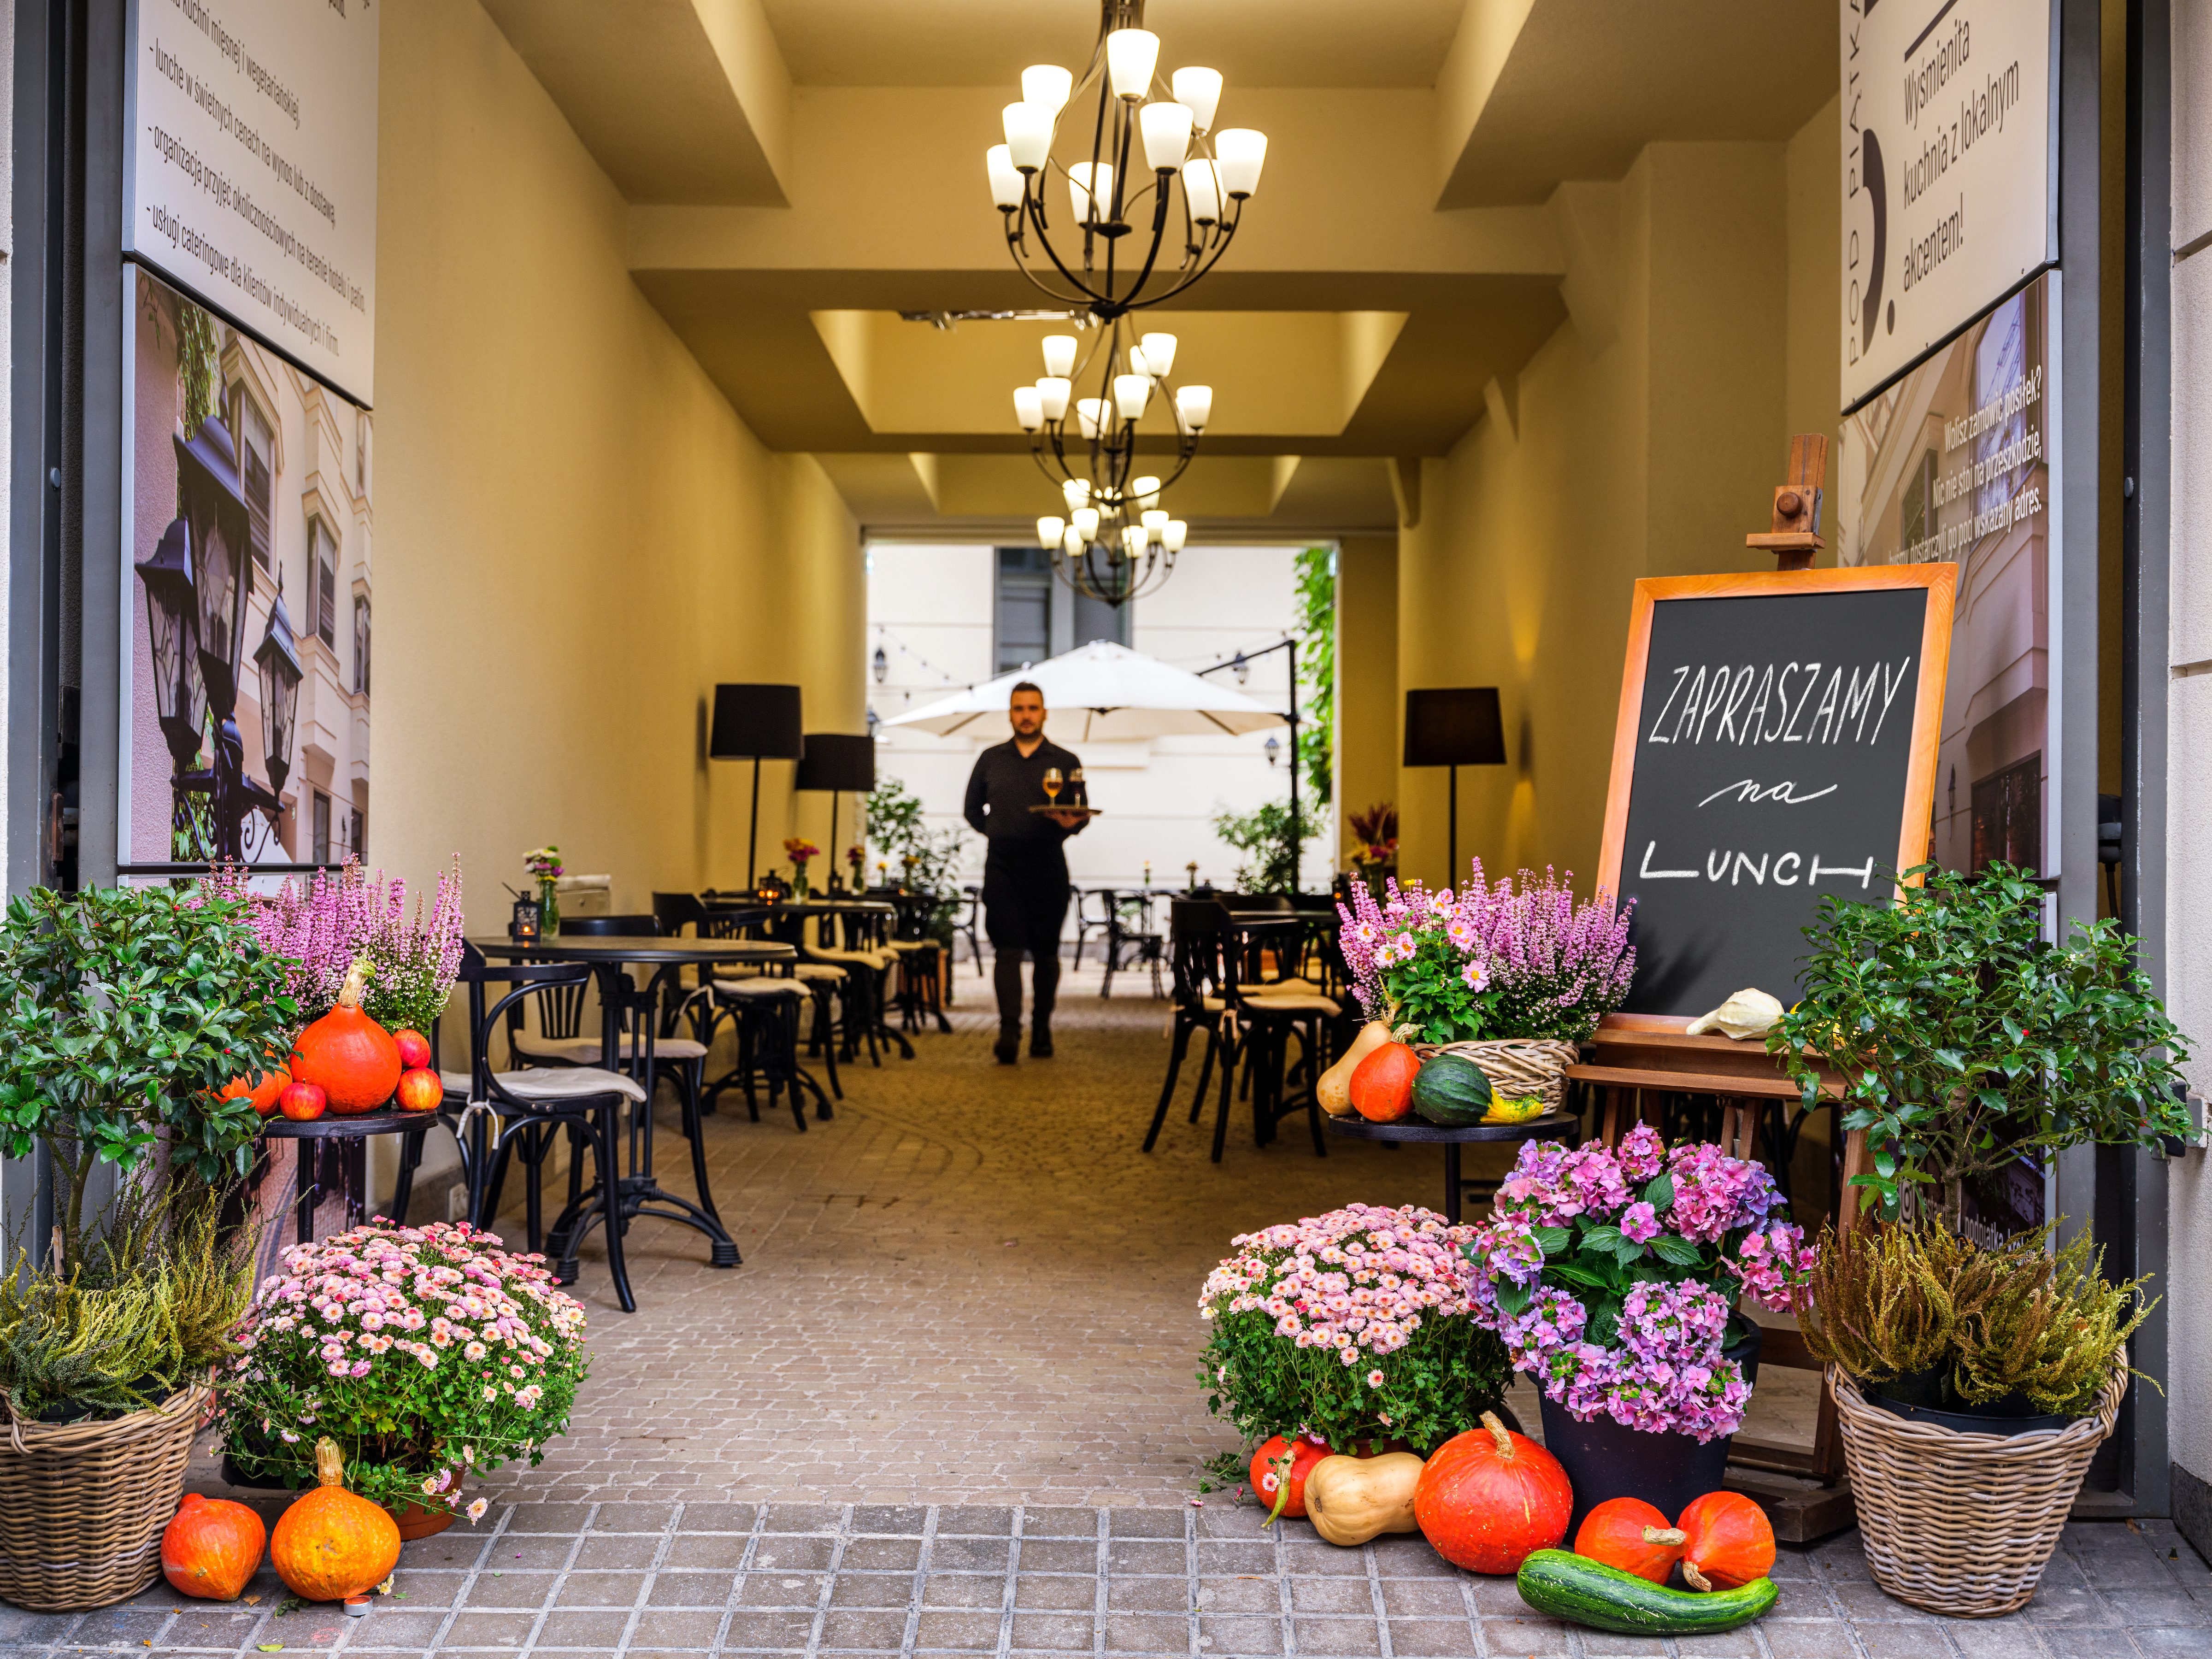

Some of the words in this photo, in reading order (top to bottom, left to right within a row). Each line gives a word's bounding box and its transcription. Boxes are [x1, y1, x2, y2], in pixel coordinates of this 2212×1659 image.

[156, 37, 183, 89] lunche
[186, 72, 193, 97] w
[194, 75, 233, 133] świetnych
[235, 117, 260, 158] cenach
[262, 141, 271, 167] na
[272, 150, 293, 187] wynos
[294, 164, 304, 196] lub
[305, 181, 309, 201] z
[212, 19, 240, 74] mięsnej
[242, 43, 244, 71] i
[247, 54, 300, 130] wegetariańskiej,
[1904, 18, 1970, 131] Wyśmienita
[1905, 125, 1947, 210] kuchnia
[1952, 122, 1958, 164] z
[1962, 60, 2018, 154] lokalnym
[154, 126, 201, 187] organizacja
[204, 166, 231, 209] przyjęć
[233, 185, 296, 258] okolicznościowych
[297, 242, 305, 265] na
[306, 245, 328, 283] terenie
[328, 261, 346, 299] hotelu
[1904, 192, 1963, 293] akcentem!
[153, 204, 179, 249] usługi
[182, 226, 229, 278] cateringowe
[231, 256, 241, 288] dla
[243, 263, 272, 309] klientów
[274, 285, 321, 345] indywidualnych
[1849, 229, 1859, 367] POD
[1945, 415, 1967, 453] Wolisz
[1969, 389, 2003, 440] zamówić
[2005, 364, 2042, 427] posiłek?
[1933, 477, 1945, 509] Nic
[1946, 470, 1957, 503] nie
[1959, 459, 1972, 496] stoi
[1974, 461, 1984, 488] na
[1986, 424, 2041, 490] przeszkodzie,
[1910, 523, 1947, 564] dostarczyli
[1947, 525, 1957, 559] go
[1959, 511, 1972, 555] pod
[1974, 499, 2013, 539] wskazany
[2015, 484, 2042, 522] adres.
[1648, 656, 1911, 746] ZAPRASZAMY
[1697, 778, 1838, 808] na
[1639, 840, 1875, 889] LUNCH
